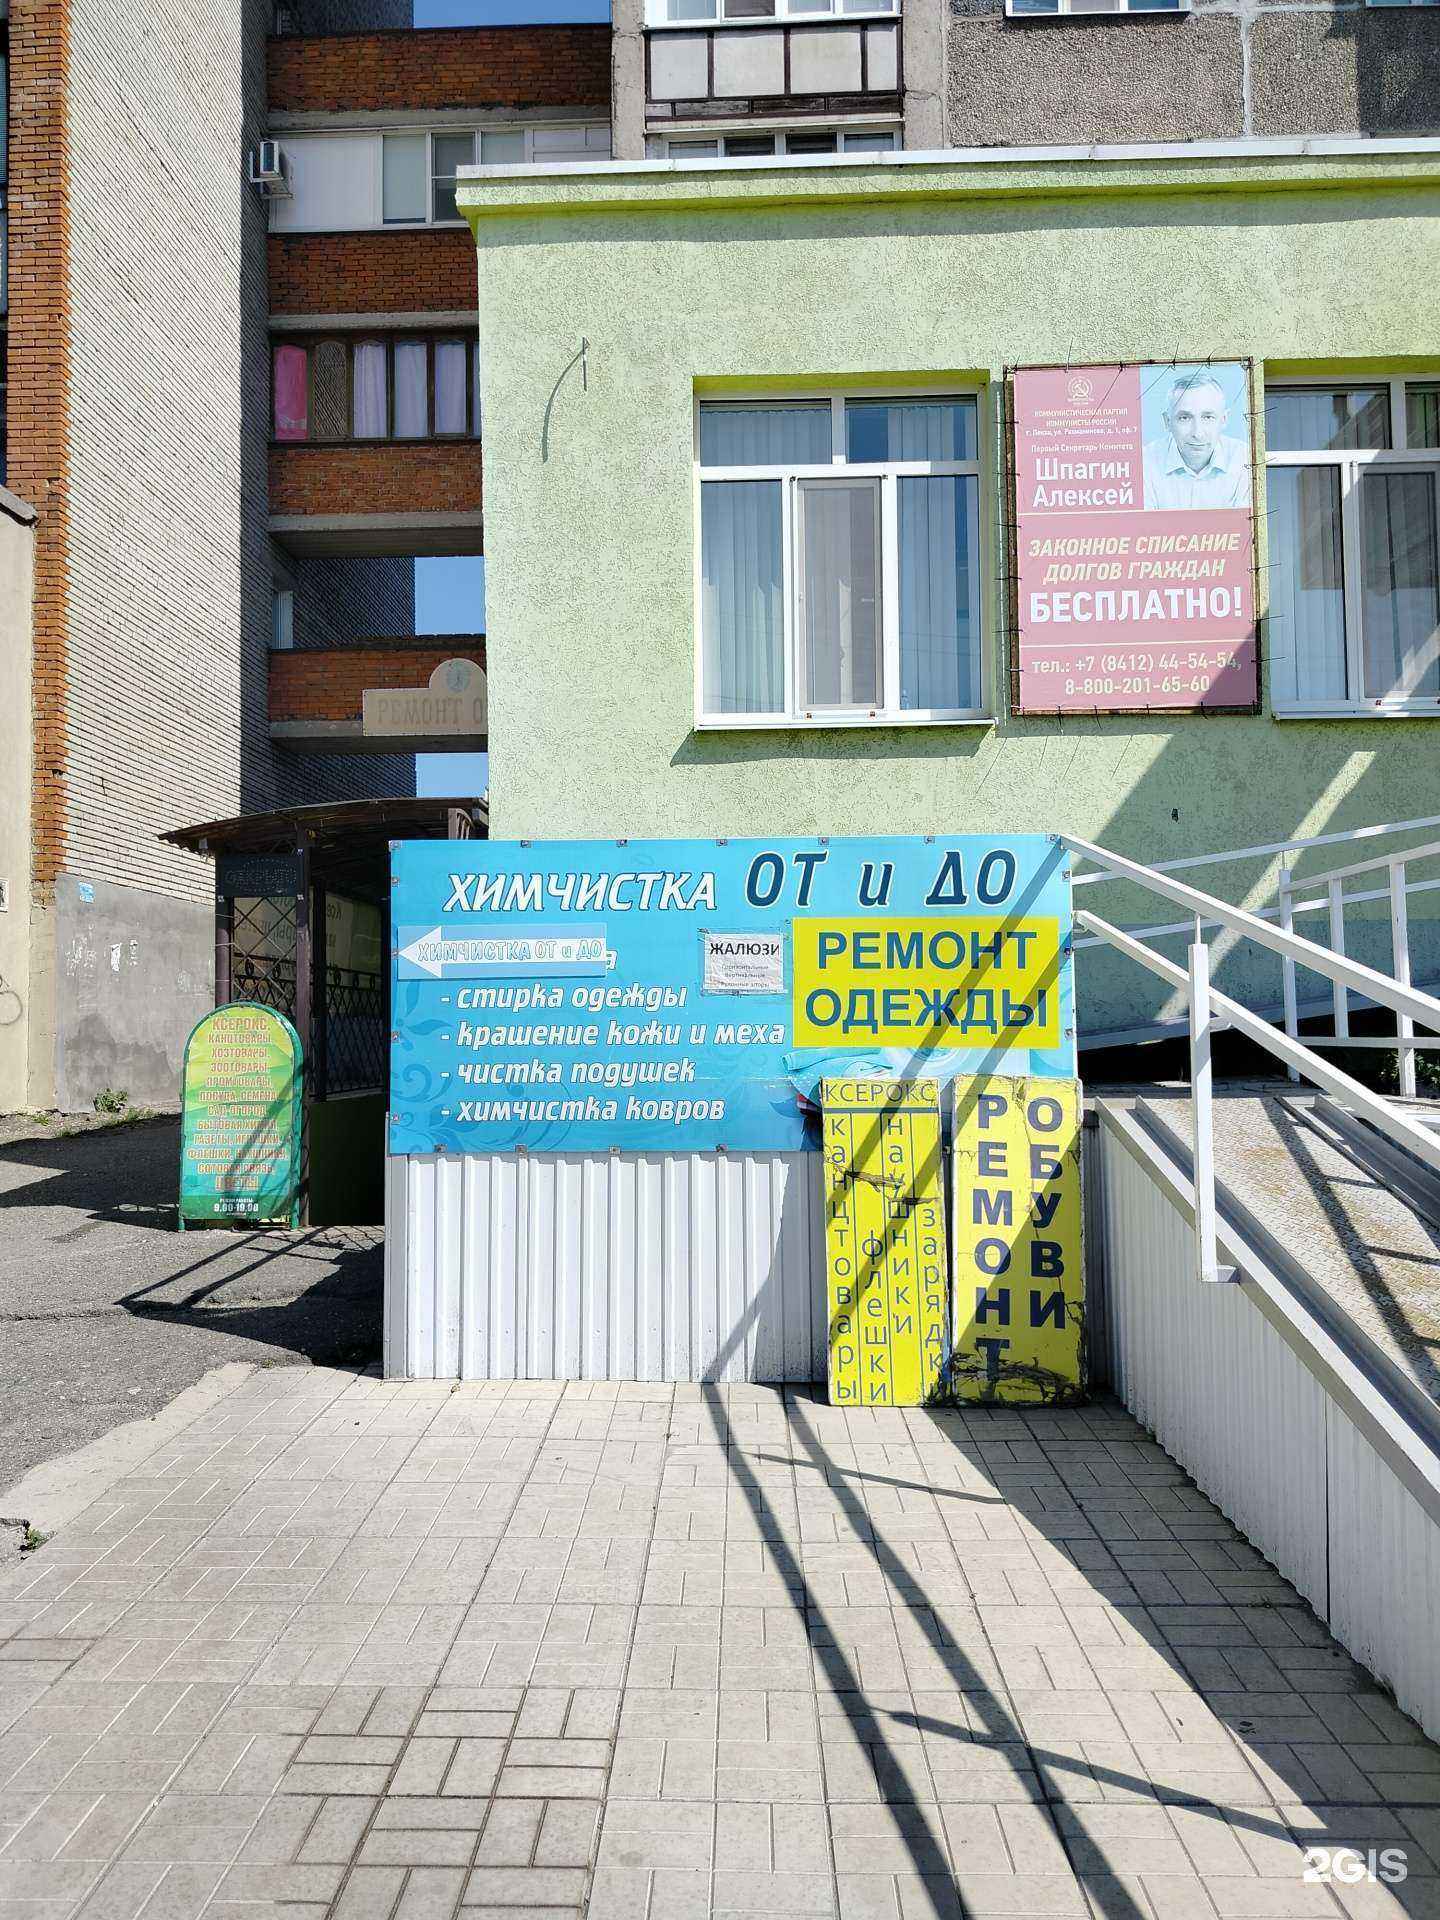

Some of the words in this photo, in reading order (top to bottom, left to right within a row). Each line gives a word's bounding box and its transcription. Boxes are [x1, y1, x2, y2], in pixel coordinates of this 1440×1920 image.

[1035, 458, 1130, 481] Шпагин
[1032, 482, 1134, 508] Алексей
[1028, 537, 1130, 557] ЗАКОННОЕ
[1135, 533, 1241, 553] СПИСАНИЕ
[1042, 562, 1122, 585] ДОЛГОВ
[1127, 559, 1226, 580] ГРАЖДАН
[1030, 586, 1243, 623] БЕСПЛАТНО!
[1075, 655, 1096, 672] +7
[1101, 653, 1154, 673] (8412)
[1158, 651, 1242, 671] 44-54-54,
[1065, 675, 1210, 695] 8-800-201-65-60
[377, 697, 463, 726] РЕМОНТ
[442, 871, 717, 912] ХИМЧИСТКА
[745, 848, 829, 908] ОТ
[857, 862, 894, 908] и
[924, 847, 1018, 908] ДО
[417, 940, 532, 962] ХИМЧИСТКА
[534, 940, 557, 960] ОТ
[560, 945, 573, 960] и
[576, 939, 602, 962] ДО
[709, 943, 780, 956] ЖАЛЮЗИ
[818, 932, 1037, 970] РЕМОНТ
[456, 984, 563, 1013] стирка
[571, 983, 687, 1013] одежды
[805, 988, 1047, 1034] ОДЕЖДЫ
[456, 1020, 599, 1050] крашение
[606, 1020, 681, 1047] кожи
[688, 1024, 708, 1045] и
[713, 1023, 785, 1046] меха
[457, 1059, 562, 1085] чистка
[570, 1057, 696, 1088] подушек
[825, 1083, 937, 1103] КСЕРОКС
[456, 1095, 617, 1122] химчистка
[625, 1096, 726, 1125] ковров
[1026, 1096, 1067, 1330] ОБУВИ
[972, 1094, 1013, 1381] РЕМОНТ
